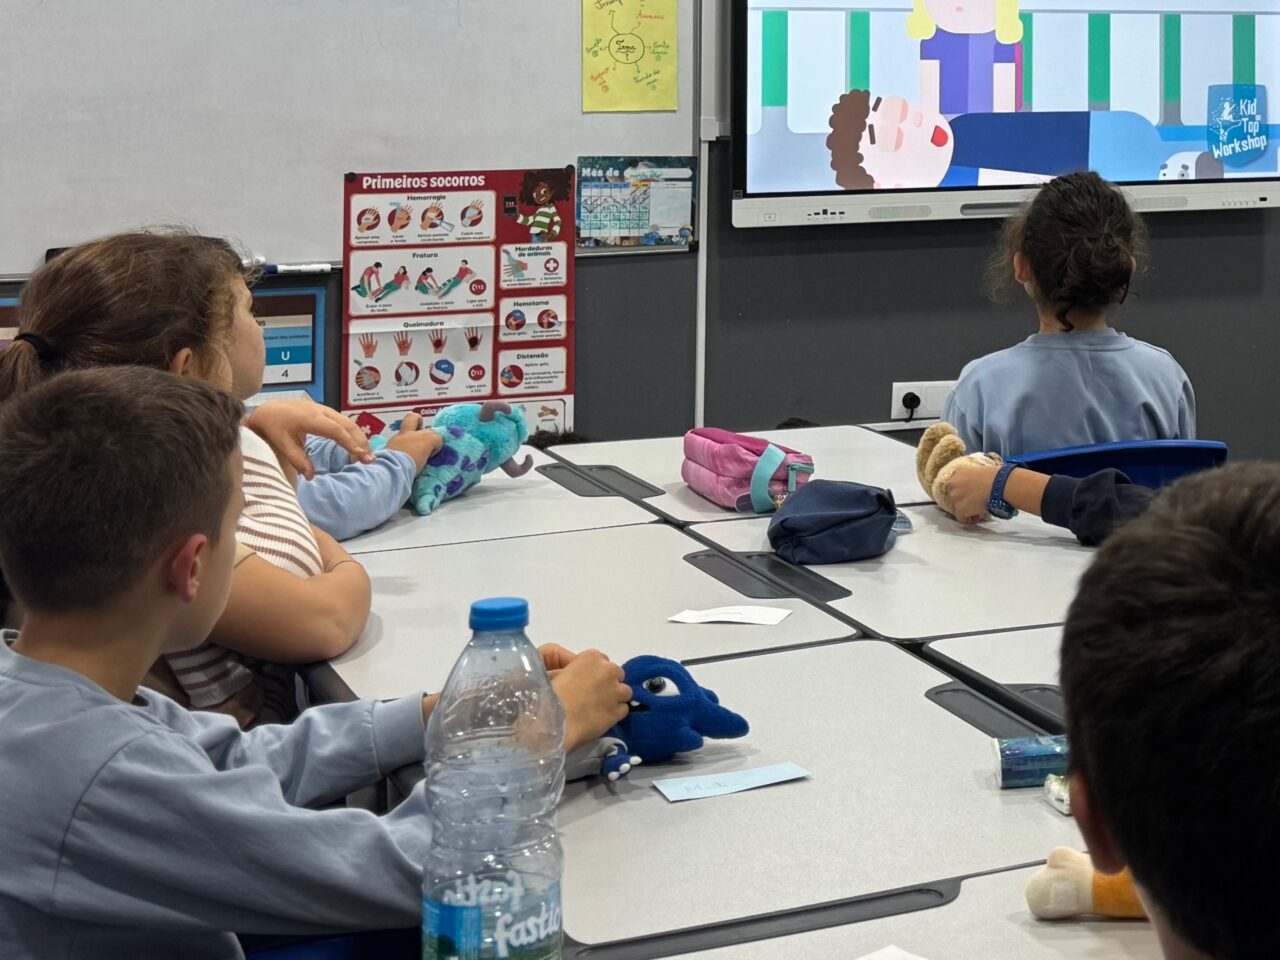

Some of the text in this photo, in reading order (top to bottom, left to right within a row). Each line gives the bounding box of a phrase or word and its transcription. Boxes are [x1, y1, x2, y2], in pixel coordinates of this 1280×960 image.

[1239, 98, 1257, 116] Kid
[1242, 118, 1260, 137] Top
[1212, 135, 1268, 160] Workshop
[362, 174, 486, 190] Primeiros socorros
[281, 351, 290, 361] U
[281, 369, 289, 379] 4
